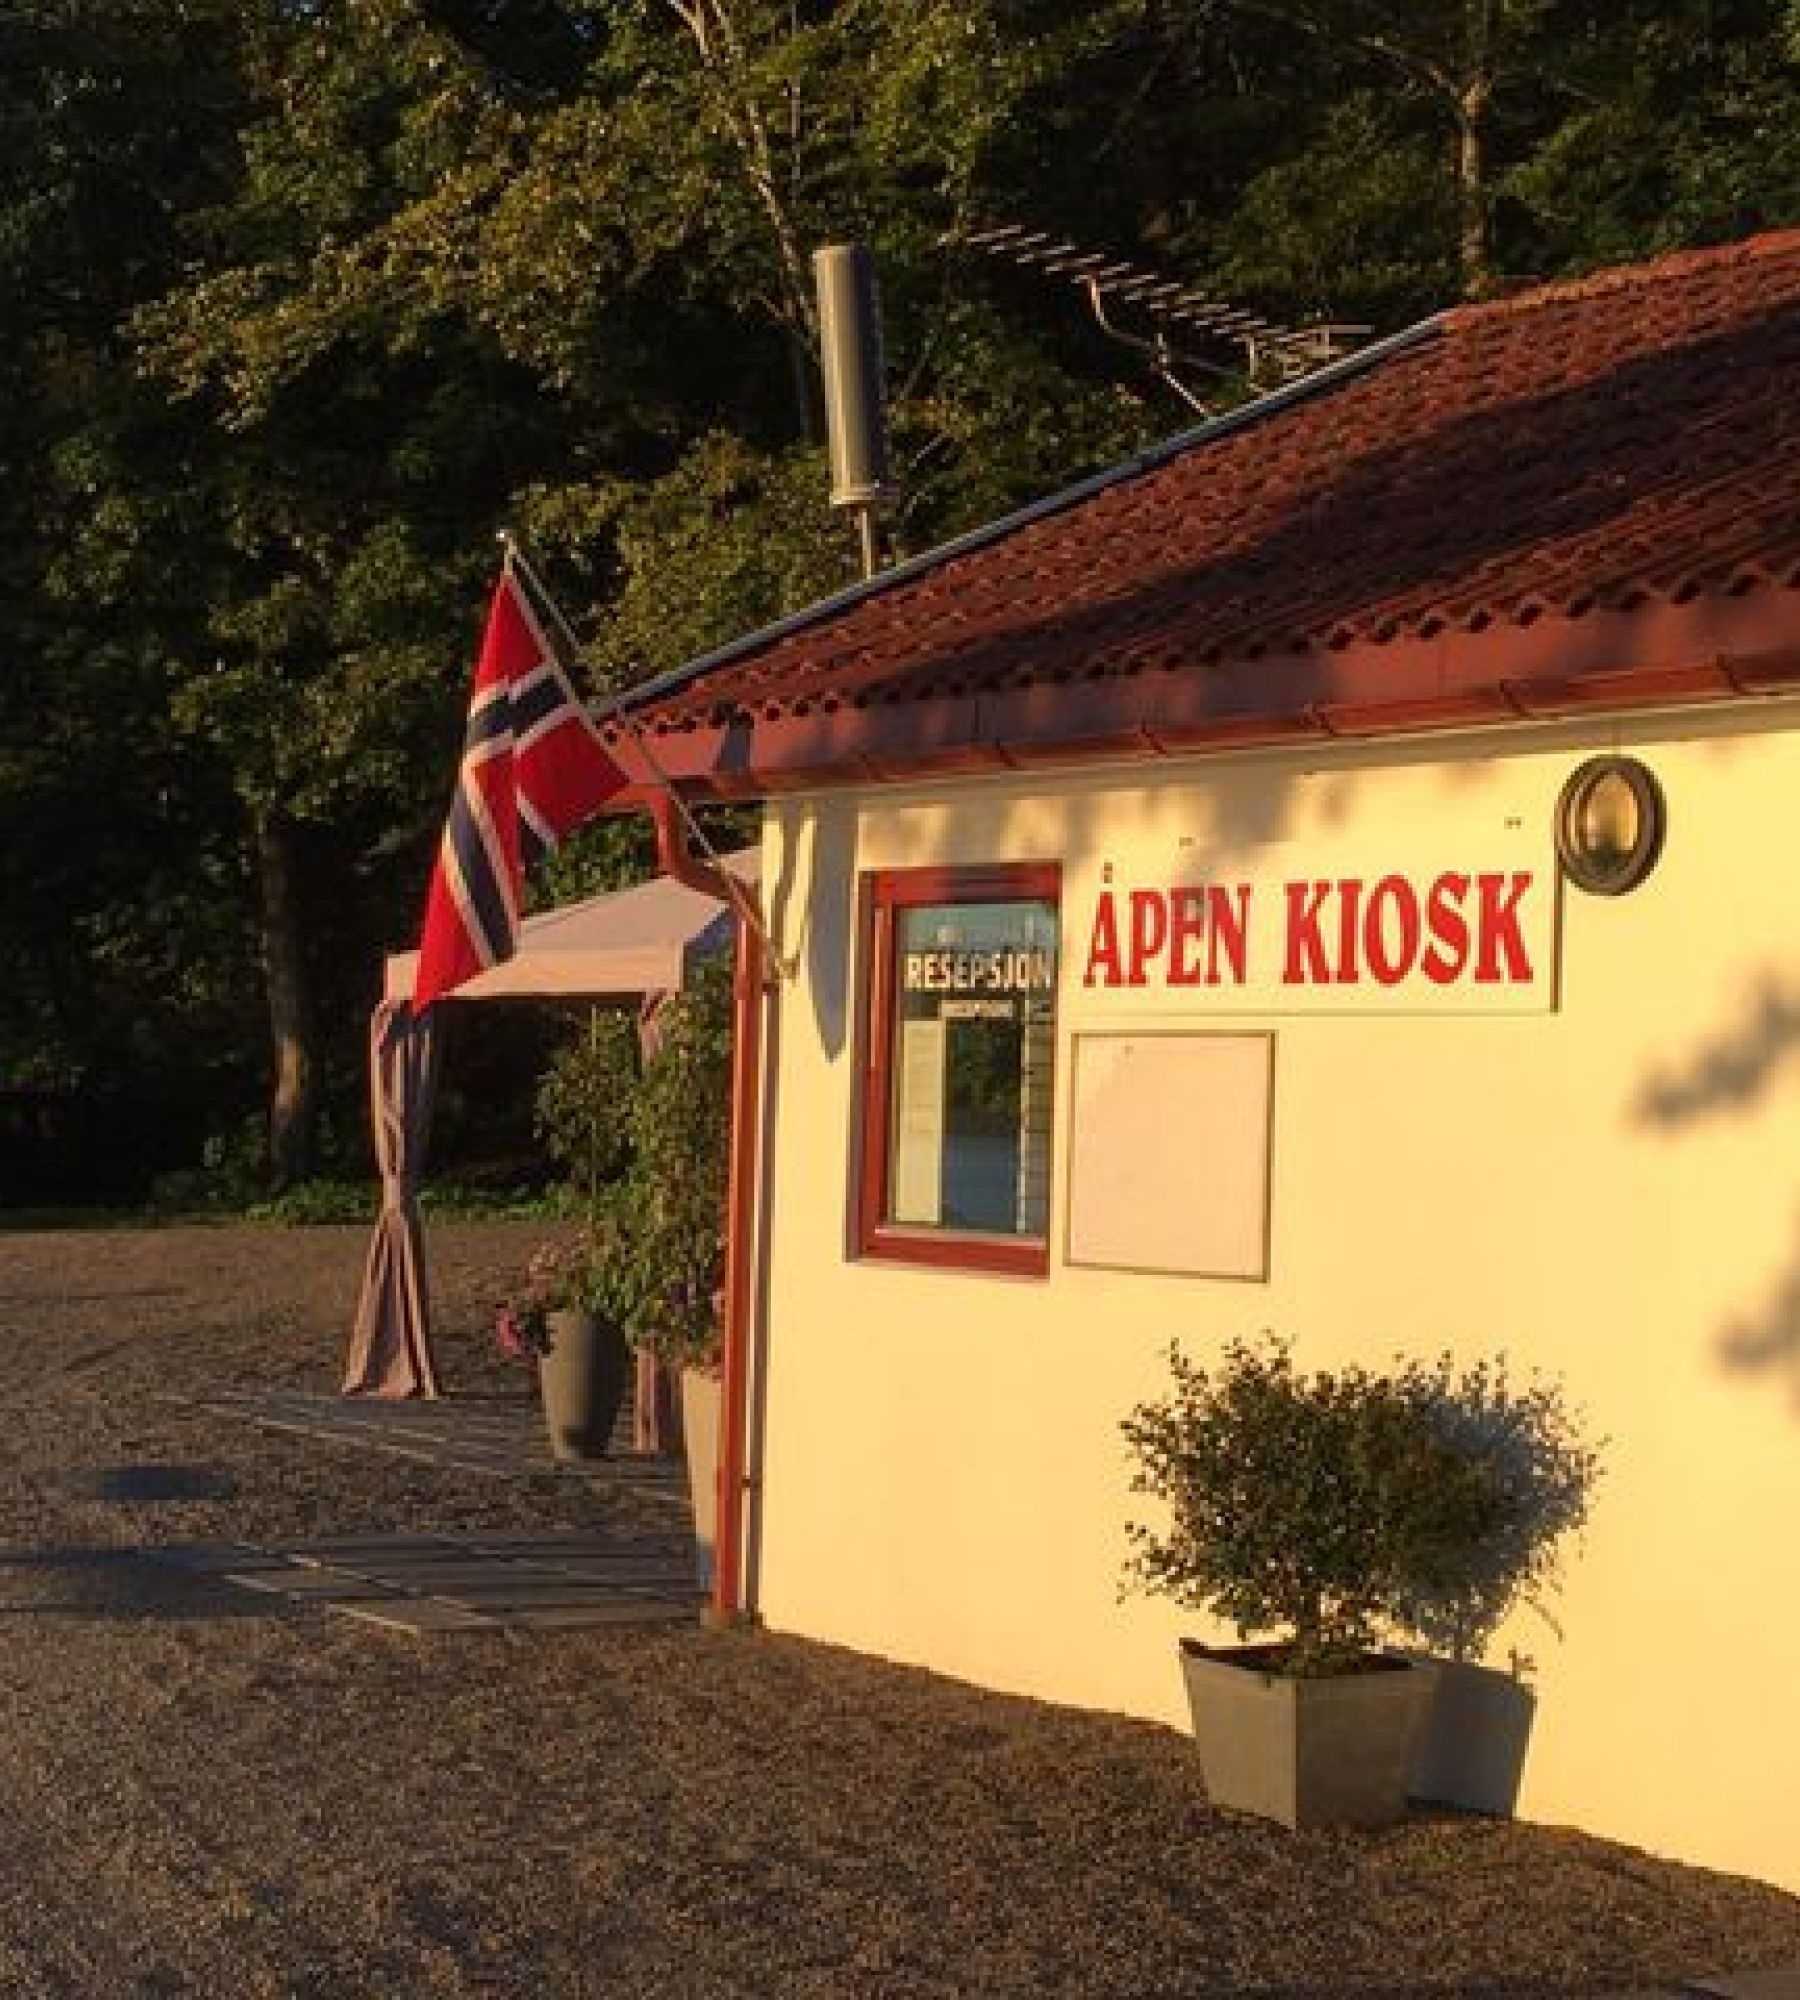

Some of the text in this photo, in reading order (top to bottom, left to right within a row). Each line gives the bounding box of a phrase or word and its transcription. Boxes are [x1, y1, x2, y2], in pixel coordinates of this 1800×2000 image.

[1083, 863, 1533, 987] ÅPEN KIOSK
[904, 953, 1052, 991] RESEPSJON
